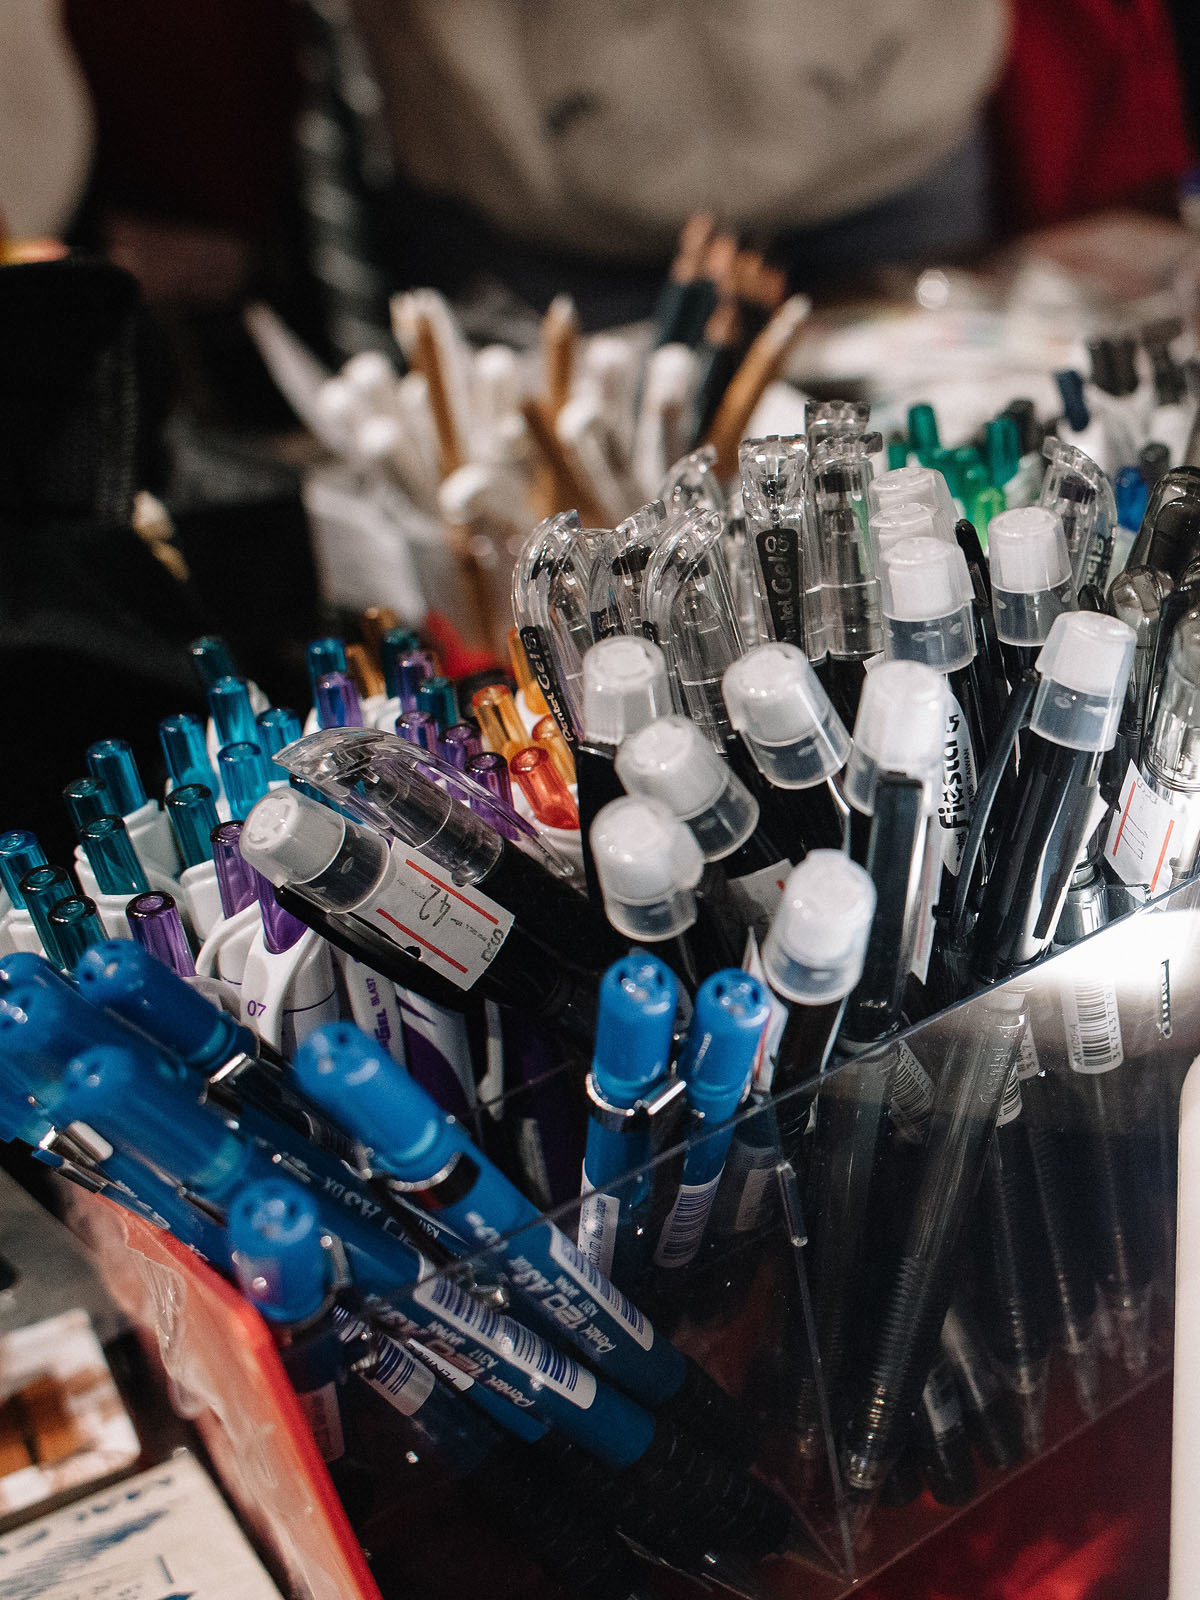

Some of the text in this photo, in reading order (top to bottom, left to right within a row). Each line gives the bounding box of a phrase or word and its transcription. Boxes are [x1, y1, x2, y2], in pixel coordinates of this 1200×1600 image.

[247, 999, 267, 1018] 07
[541, 1291, 589, 1330] 120
[579, 1322, 618, 1354] Pentel
[467, 1348, 500, 1371] A317
[486, 1374, 537, 1408] Pentel
